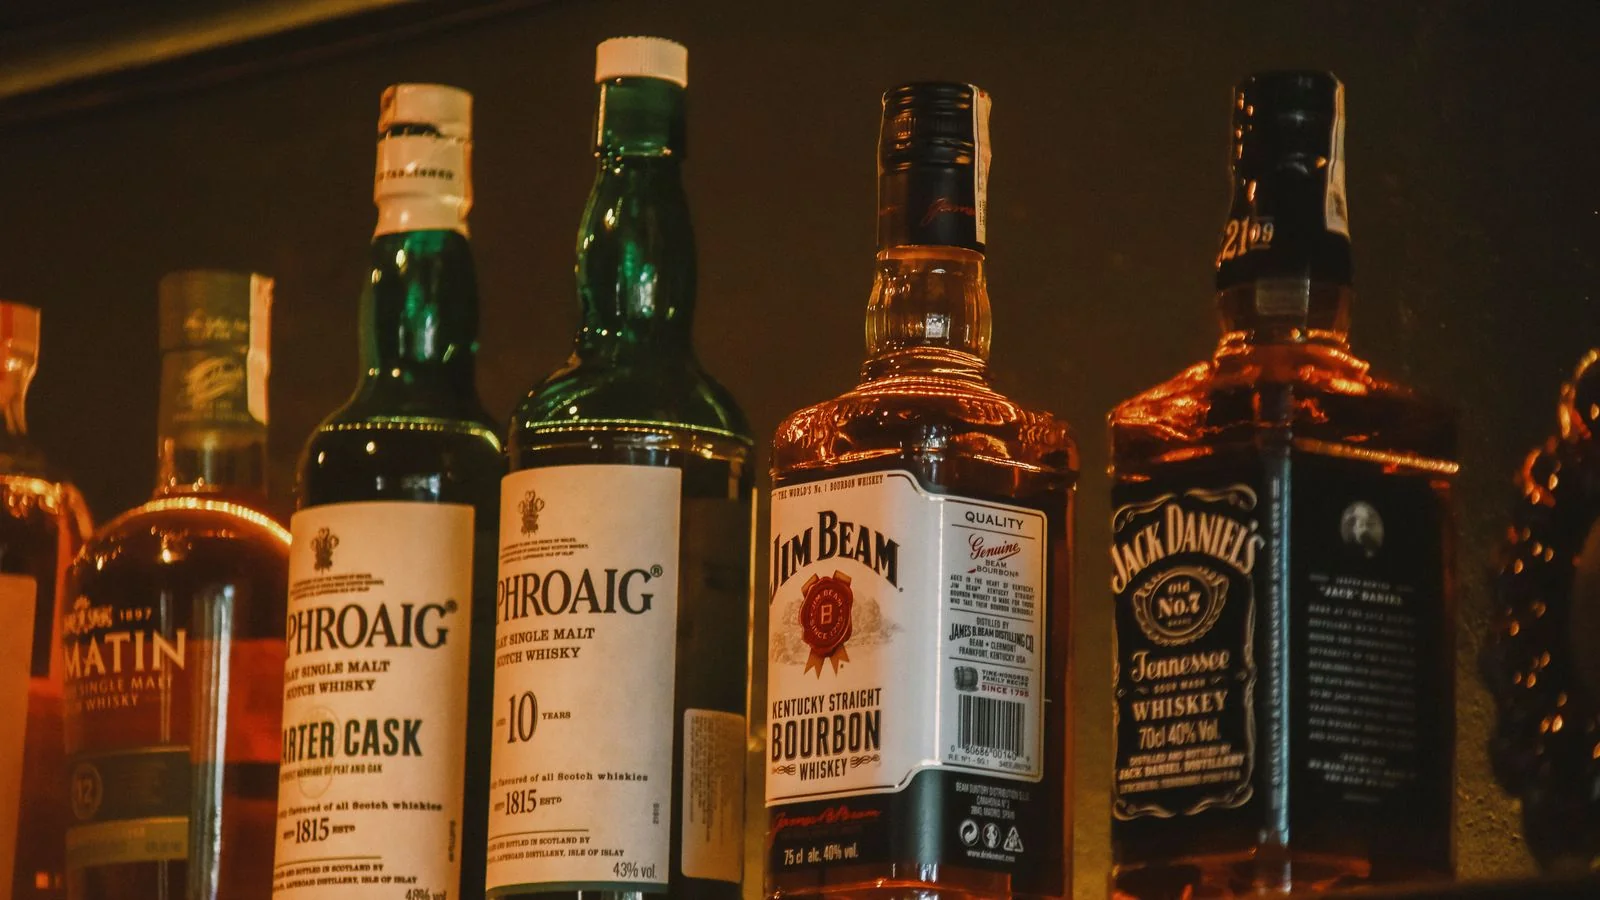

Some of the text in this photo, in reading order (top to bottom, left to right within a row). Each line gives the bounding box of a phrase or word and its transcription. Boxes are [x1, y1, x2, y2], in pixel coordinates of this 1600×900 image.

[778, 489, 787, 500] THE
[789, 485, 812, 497] WORLD'S
[830, 479, 855, 491] BOURBON
[857, 474, 884, 487] WHISKEY
[965, 511, 1024, 530] QUALITY
[968, 533, 1021, 560] Genuine
[1111, 503, 1266, 594] JACK DANIEL'S
[770, 510, 900, 605] JIM BEAM
[985, 559, 1007, 569] BEAM
[820, 603, 832, 625] B
[976, 616, 1009, 630] DISTILLED BY
[509, 630, 549, 646] SINGLE
[553, 627, 595, 641] MALT
[949, 622, 971, 641] JAMES
[977, 626, 994, 639] BEAM
[995, 629, 1026, 648] DISTILLING
[969, 637, 984, 647] BEAM
[526, 647, 581, 661] WHISKY
[989, 651, 1015, 662] KENTUCKY
[1016, 655, 1026, 664] USA
[301, 661, 343, 678] SINGLE
[347, 660, 391, 674] MALT
[1131, 650, 1230, 682] Tennessee
[982, 670, 1029, 682] TIME-HONORED
[982, 676, 1029, 688] FAMILY RECIPE
[319, 679, 377, 694] WHISKY
[981, 684, 1008, 695] SINCE
[772, 688, 882, 720] KENTUCKY STRAIGHT
[1131, 689, 1229, 722] WHISKEY
[507, 690, 571, 744] 10 YEARS
[343, 717, 423, 757] CASK
[771, 709, 882, 763] BOURBON
[1168, 720, 1197, 746] 40%
[351, 763, 366, 774] AND
[367, 762, 383, 774] OAK
[530, 773, 540, 783] of
[541, 773, 555, 782] all
[557, 772, 593, 782] Scotch
[598, 772, 649, 782] whiskies
[799, 757, 848, 781] WHISKEY
[323, 801, 334, 812] of
[335, 801, 350, 811] all
[352, 801, 389, 810] Scotch
[392, 800, 443, 812] whiskies
[505, 788, 538, 816] 1815
[295, 816, 330, 845] 1815
[530, 838, 538, 846] IN
[539, 836, 577, 845] SCOTLAND
[579, 836, 591, 845] BY
[568, 848, 586, 857] ISLE
[587, 848, 599, 857] OF
[600, 848, 625, 857] ISLAY
[784, 842, 859, 866] 75 cl alc. 40% vol.
[322, 865, 331, 873] IN
[331, 864, 370, 872] SCOTLAND
[372, 863, 385, 872] BY
[612, 861, 658, 879] 43% vol.
[361, 876, 380, 884] ISLE
[381, 876, 393, 884] OF
[393, 876, 418, 884] ISLAY
